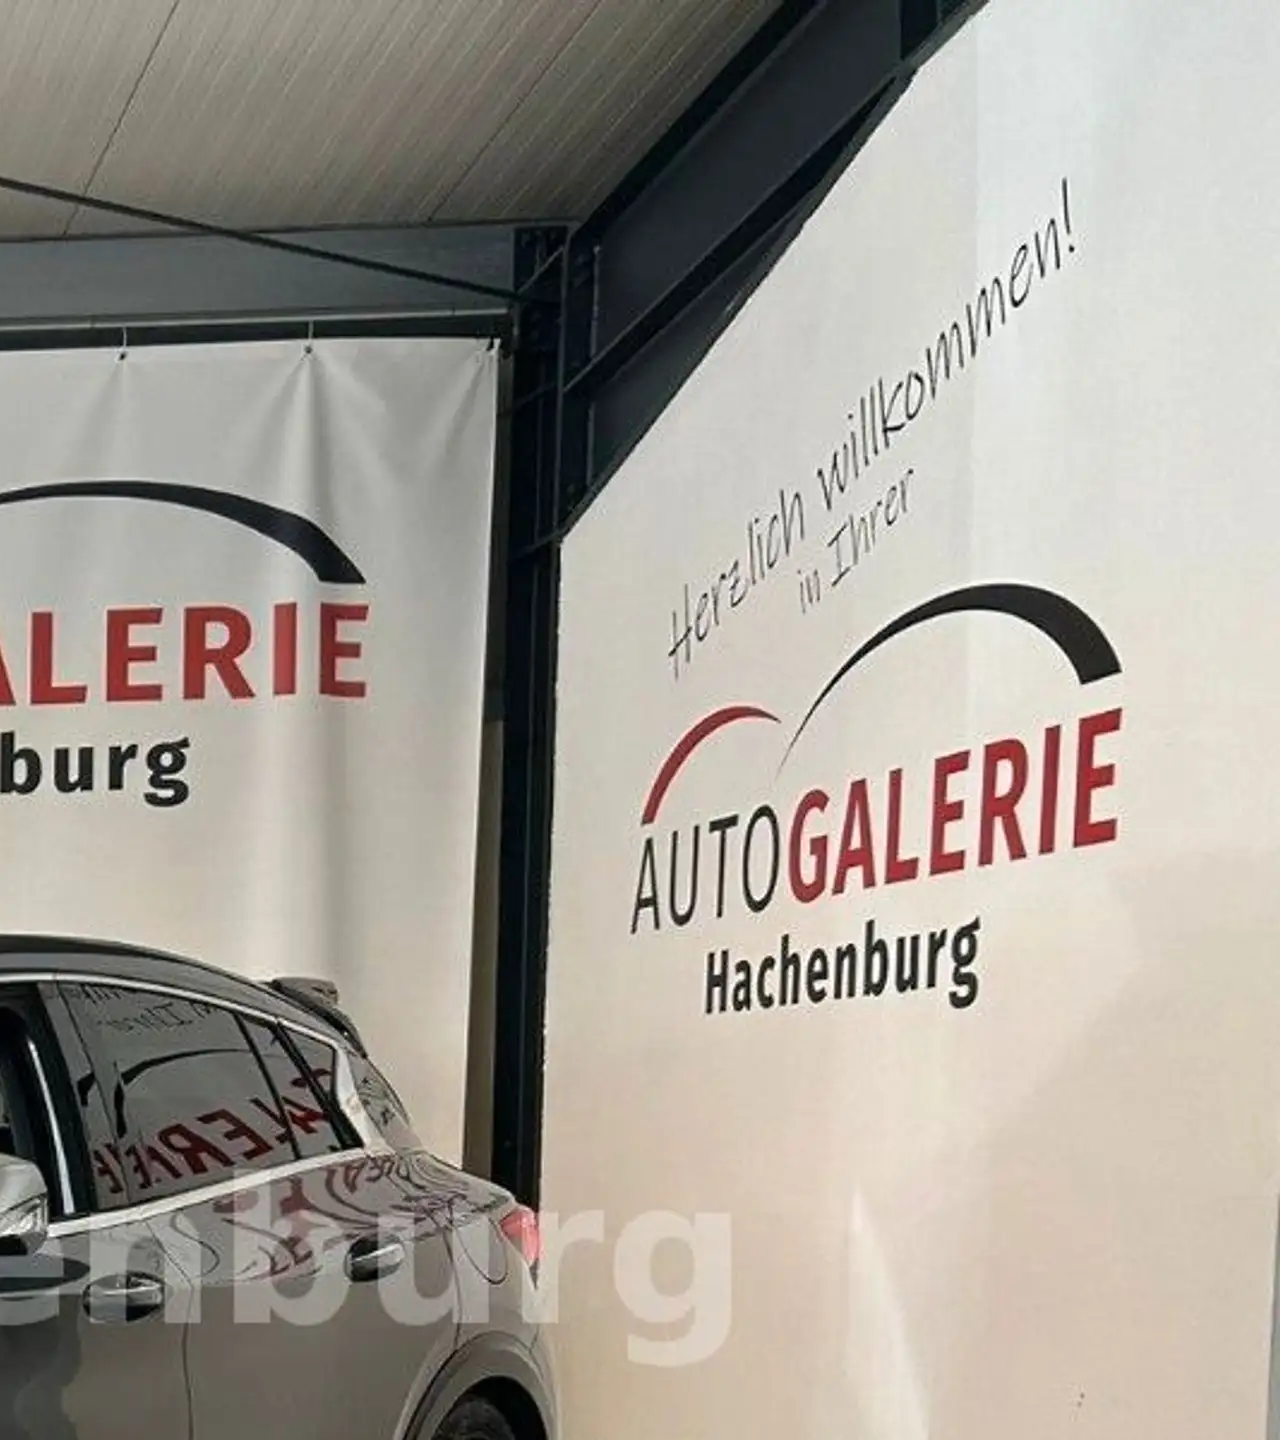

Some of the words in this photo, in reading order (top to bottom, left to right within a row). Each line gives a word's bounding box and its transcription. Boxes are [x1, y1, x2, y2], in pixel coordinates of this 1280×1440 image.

[667, 489, 804, 683] Herzlich
[816, 176, 1076, 511] willkommen!
[796, 568, 821, 615] in
[826, 467, 915, 588] Ihrer
[631, 707, 1123, 935] AUTOGALERIE
[705, 915, 982, 1015] Hachenburg
